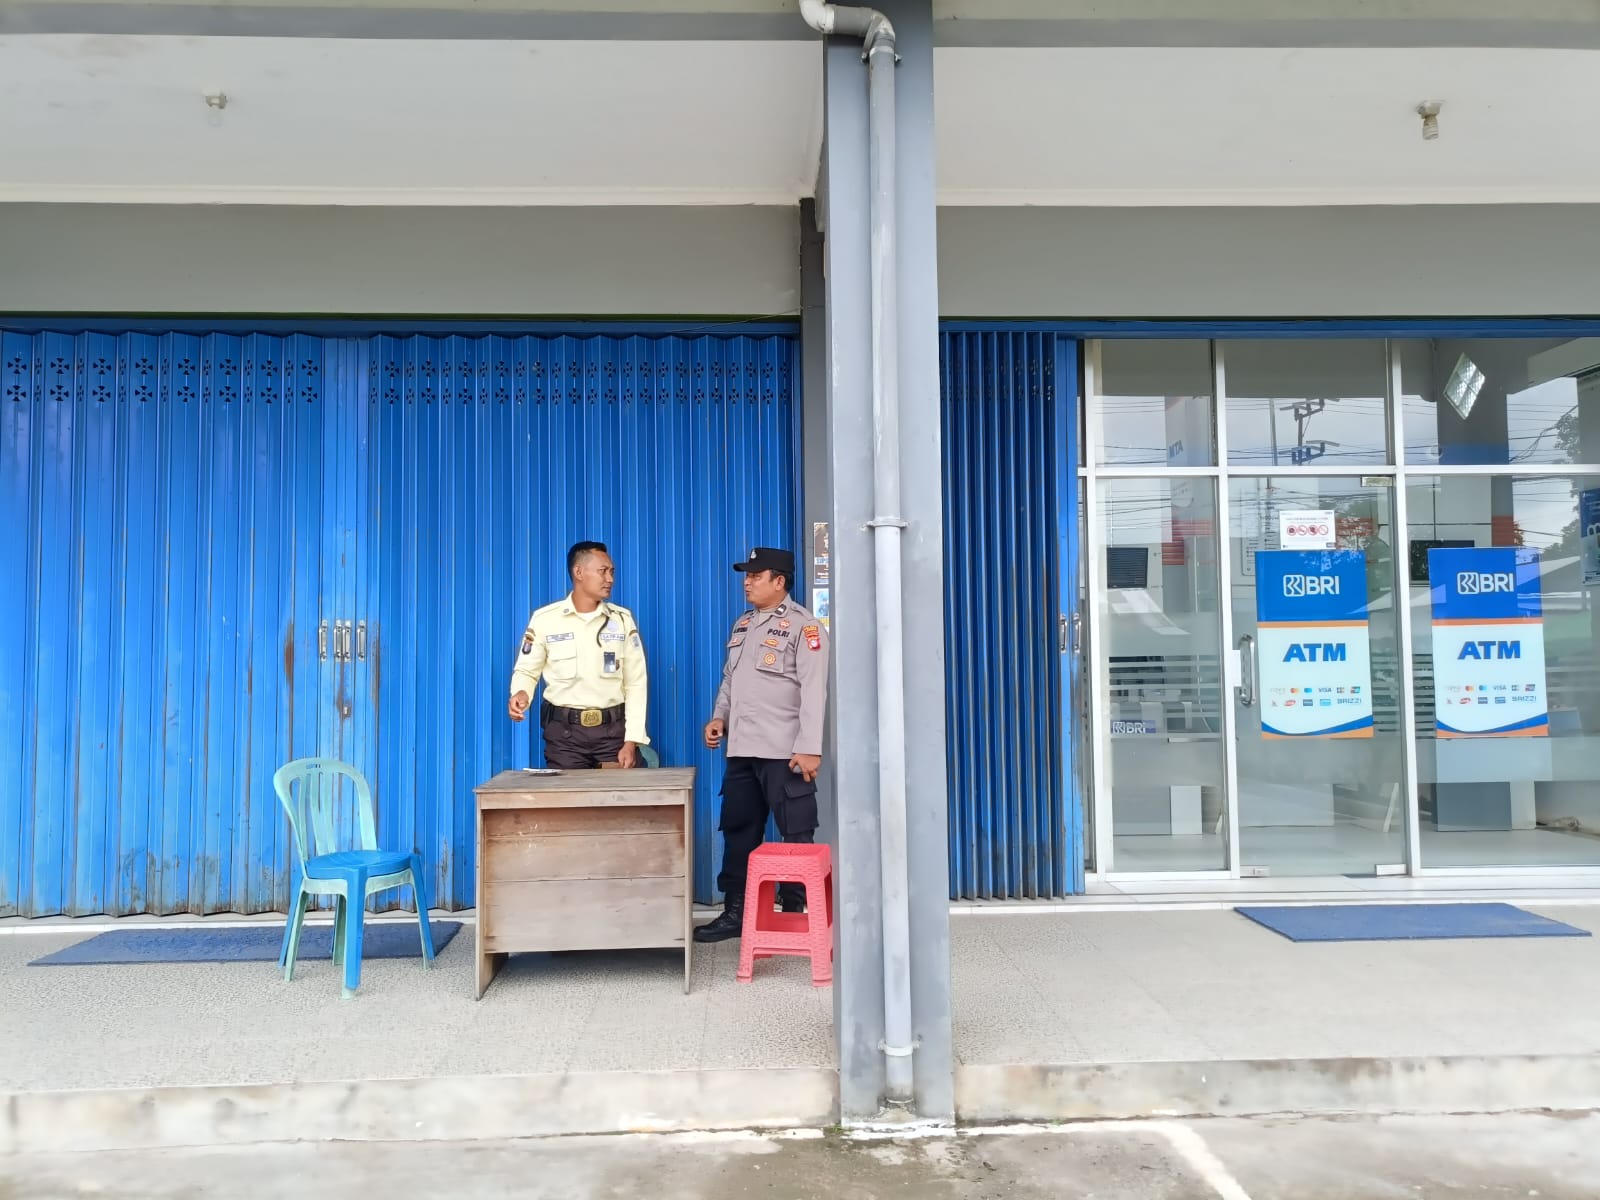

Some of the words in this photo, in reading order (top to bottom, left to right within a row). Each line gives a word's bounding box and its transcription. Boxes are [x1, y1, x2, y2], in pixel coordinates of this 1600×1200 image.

[1305, 575, 1340, 595] BRI
[1480, 573, 1515, 593] BRI
[767, 628, 790, 638] POLRI
[1282, 643, 1346, 662] ATM
[1457, 640, 1521, 660] ATM
[1126, 721, 1146, 734] BRI
